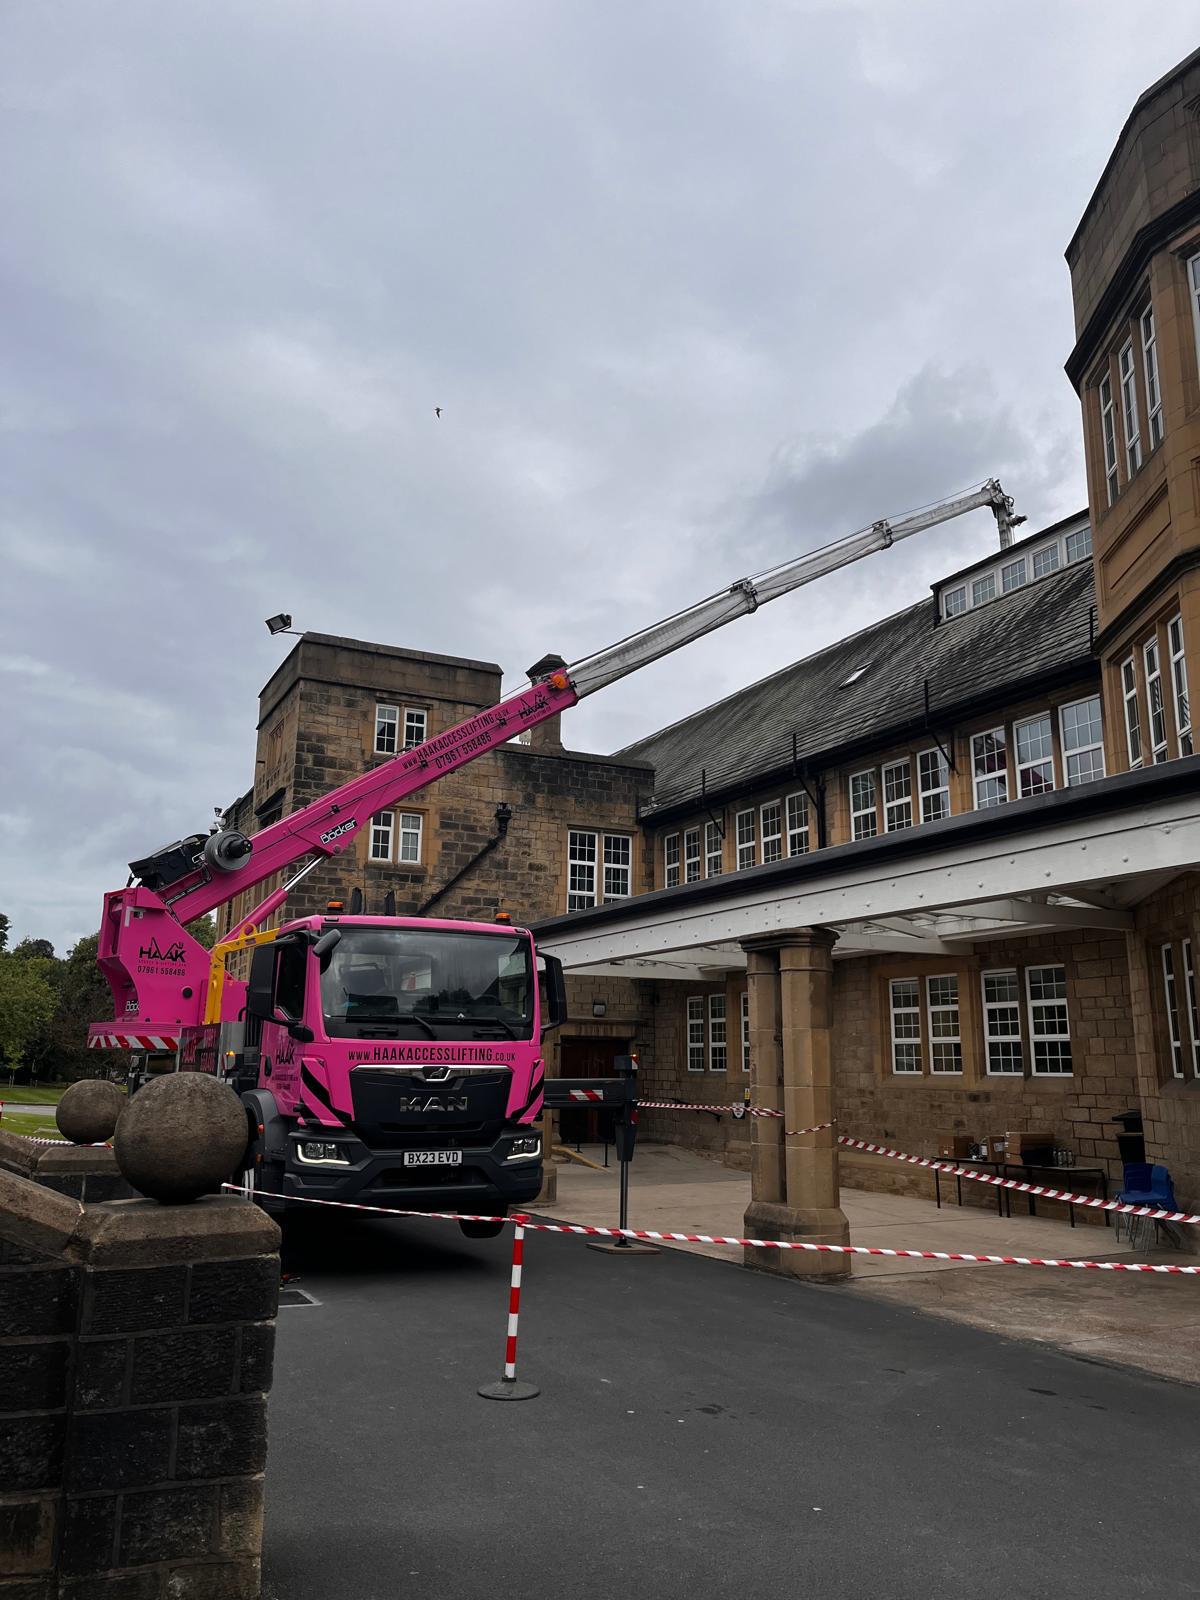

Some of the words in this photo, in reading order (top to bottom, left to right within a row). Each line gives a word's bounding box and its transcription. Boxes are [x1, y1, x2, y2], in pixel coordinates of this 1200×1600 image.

[435, 746, 461, 769] 07961
[320, 819, 356, 844] Böcker
[139, 937, 186, 962] HAAK
[400, 1097, 468, 1112] MAN
[408, 1152, 435, 1164] BX23
[438, 1151, 458, 1163] EVD
